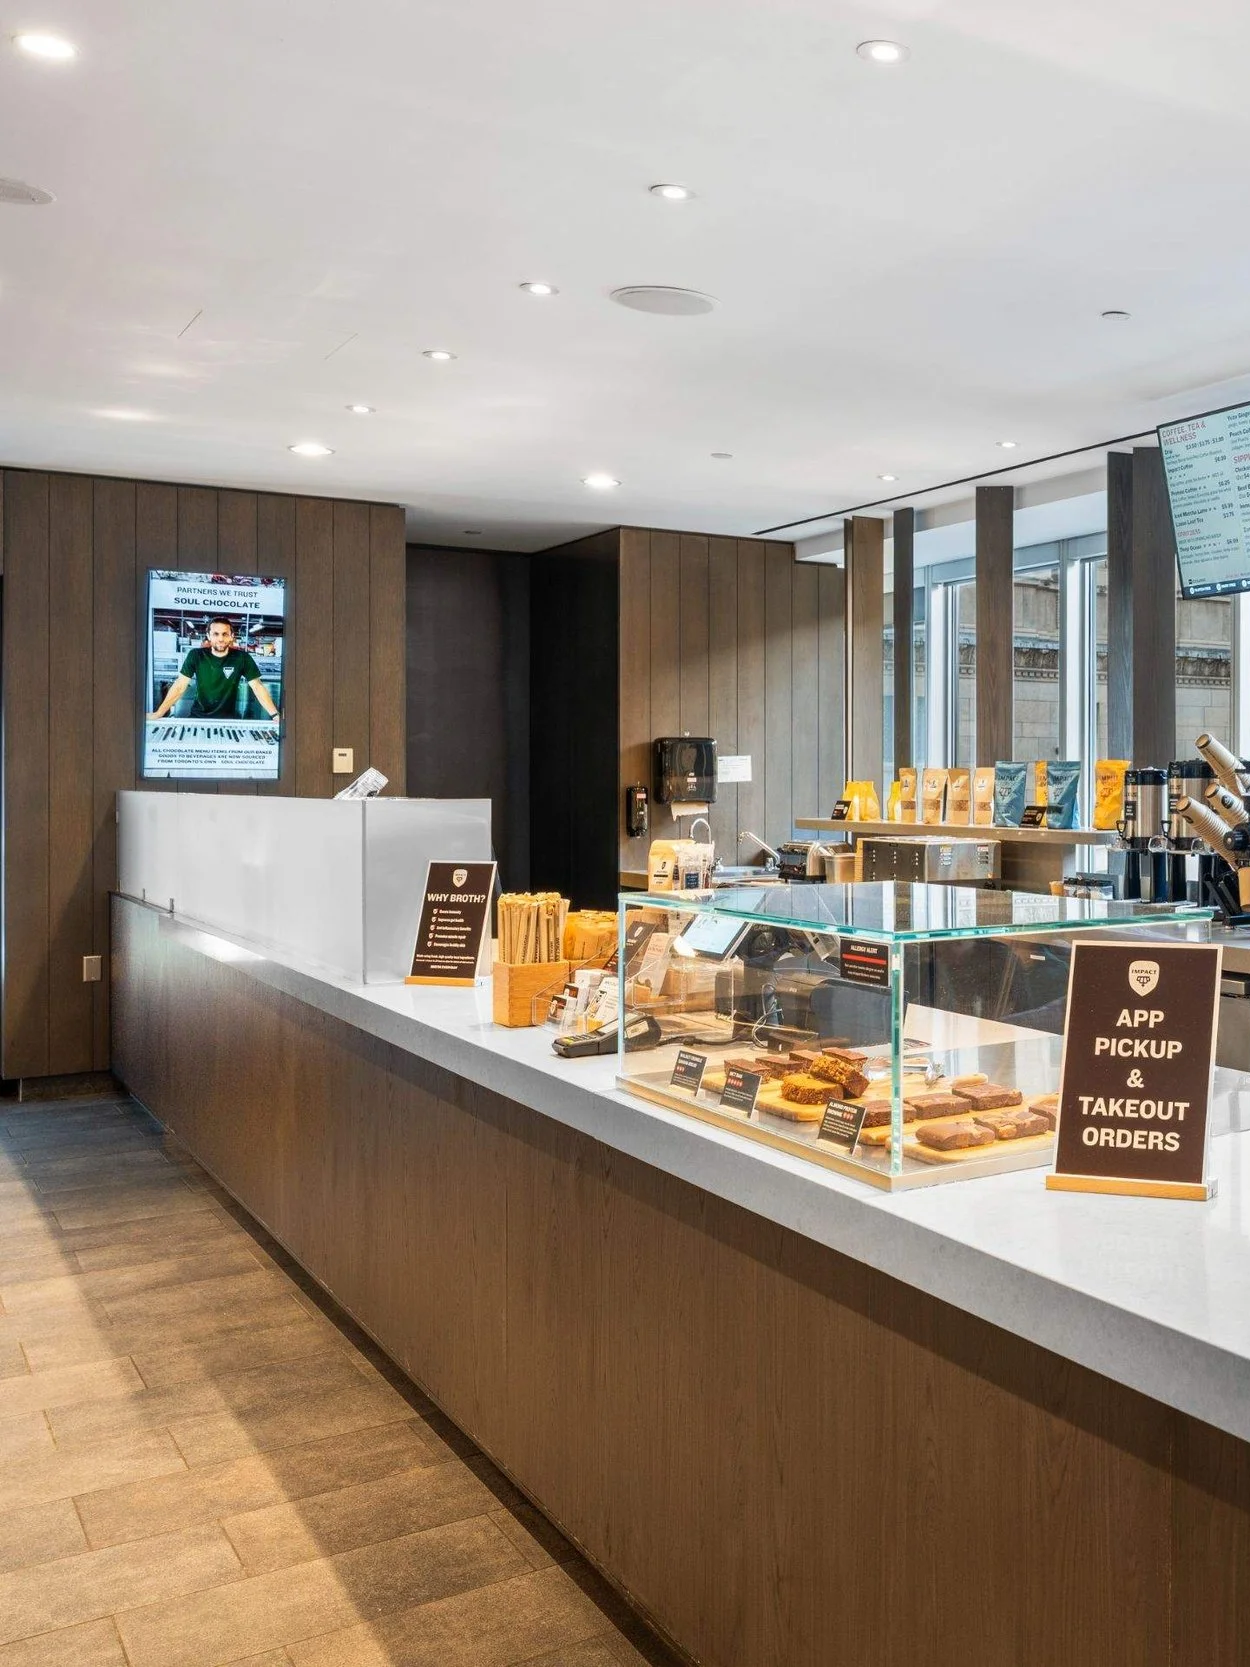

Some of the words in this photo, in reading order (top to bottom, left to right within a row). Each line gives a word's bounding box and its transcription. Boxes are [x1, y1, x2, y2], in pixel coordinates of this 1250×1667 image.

[1188, 422, 1199, 431] TEA
[1163, 432, 1196, 445] WELLNESS
[177, 587, 218, 595] PARTNERS
[234, 590, 258, 598] TRUST
[174, 597, 200, 605] SOUL
[202, 599, 260, 609] CHOCOLATE
[427, 893, 449, 902] WHY
[449, 894, 486, 903] BROTH?
[1116, 1008, 1165, 1028] APP
[1094, 1037, 1183, 1059] PICKUP
[1126, 1068, 1144, 1088] &
[1079, 1096, 1190, 1121] TAKEOUT
[1082, 1126, 1180, 1152] ORDERS
